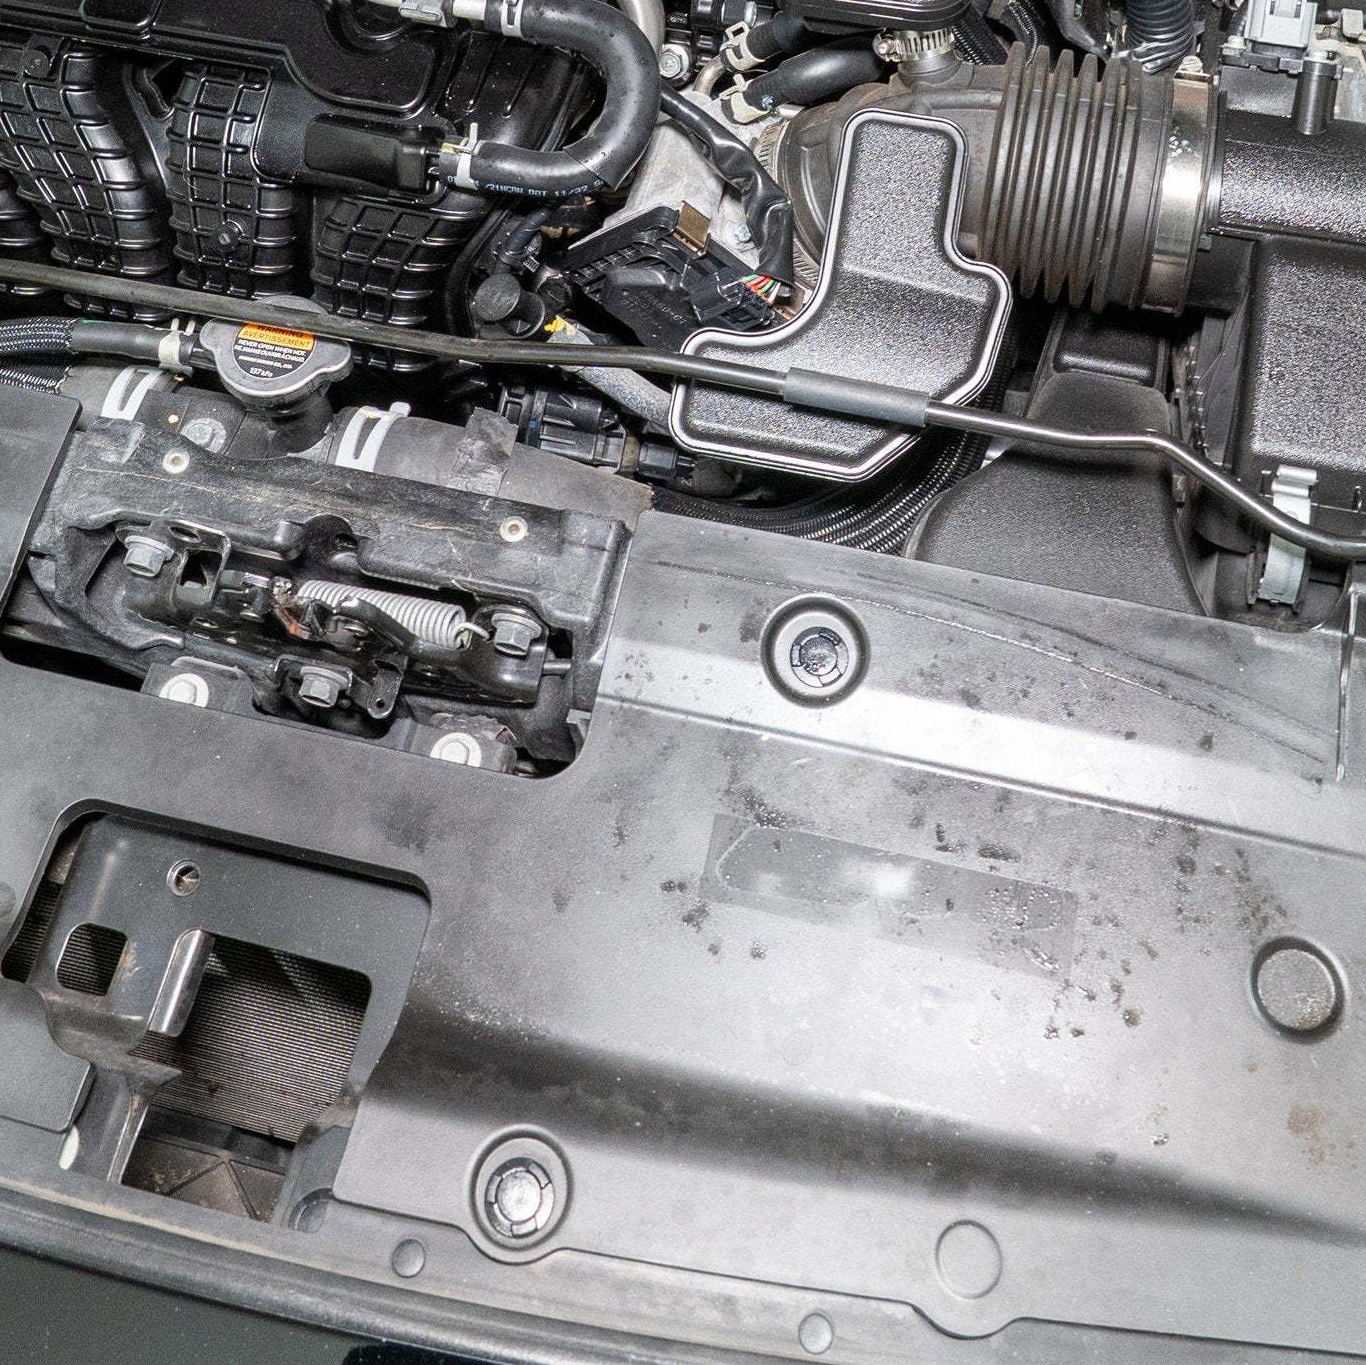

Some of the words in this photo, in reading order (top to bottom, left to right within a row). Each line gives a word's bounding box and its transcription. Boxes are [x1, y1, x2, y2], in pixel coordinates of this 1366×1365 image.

[257, 325, 303, 338] WARNING
[243, 331, 310, 347] AVERTISSEMENT
[238, 339, 258, 347] NEVER
[258, 342, 274, 351] OPEN
[275, 345, 293, 354] WHEN
[262, 369, 273, 377] kPa
